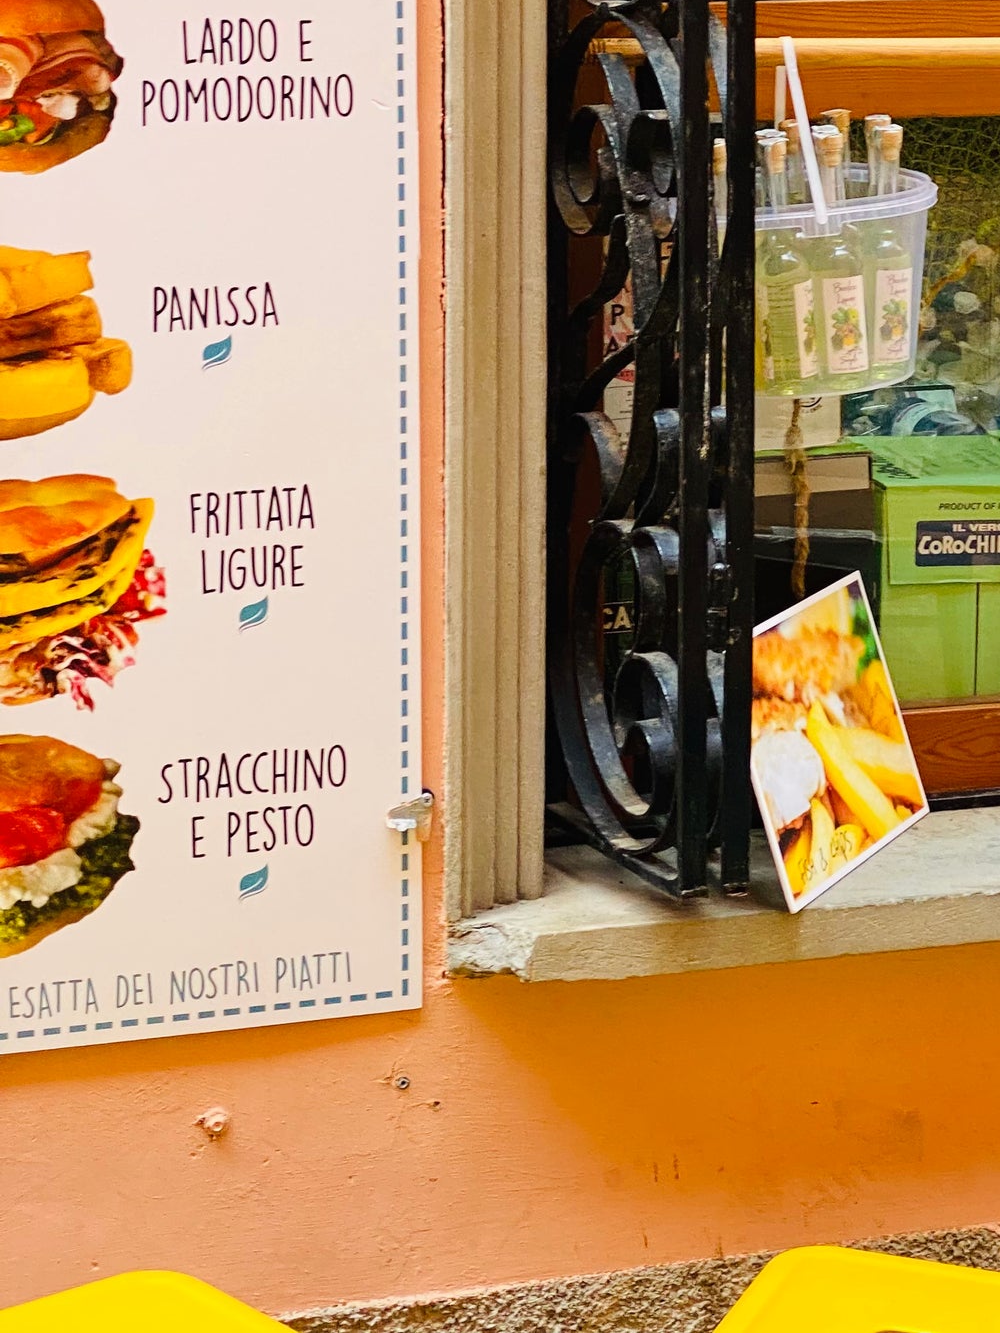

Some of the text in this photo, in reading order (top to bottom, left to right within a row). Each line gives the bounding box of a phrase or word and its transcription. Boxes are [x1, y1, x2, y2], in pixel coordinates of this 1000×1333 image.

[181, 17, 314, 66] LARDO E
[141, 73, 354, 127] POMODORINO
[152, 281, 280, 333] PANISSA
[189, 483, 315, 539] FRITTATA
[938, 502, 981, 511] PRODUCT
[984, 502, 996, 510] OF
[952, 523, 966, 532] IL
[200, 543, 305, 597] LIGURE
[157, 743, 347, 804] STRACCHINO
[191, 802, 315, 859] E PESTO
[8, 951, 352, 1019] ESATTA DEI NOSTRI PIATTI
